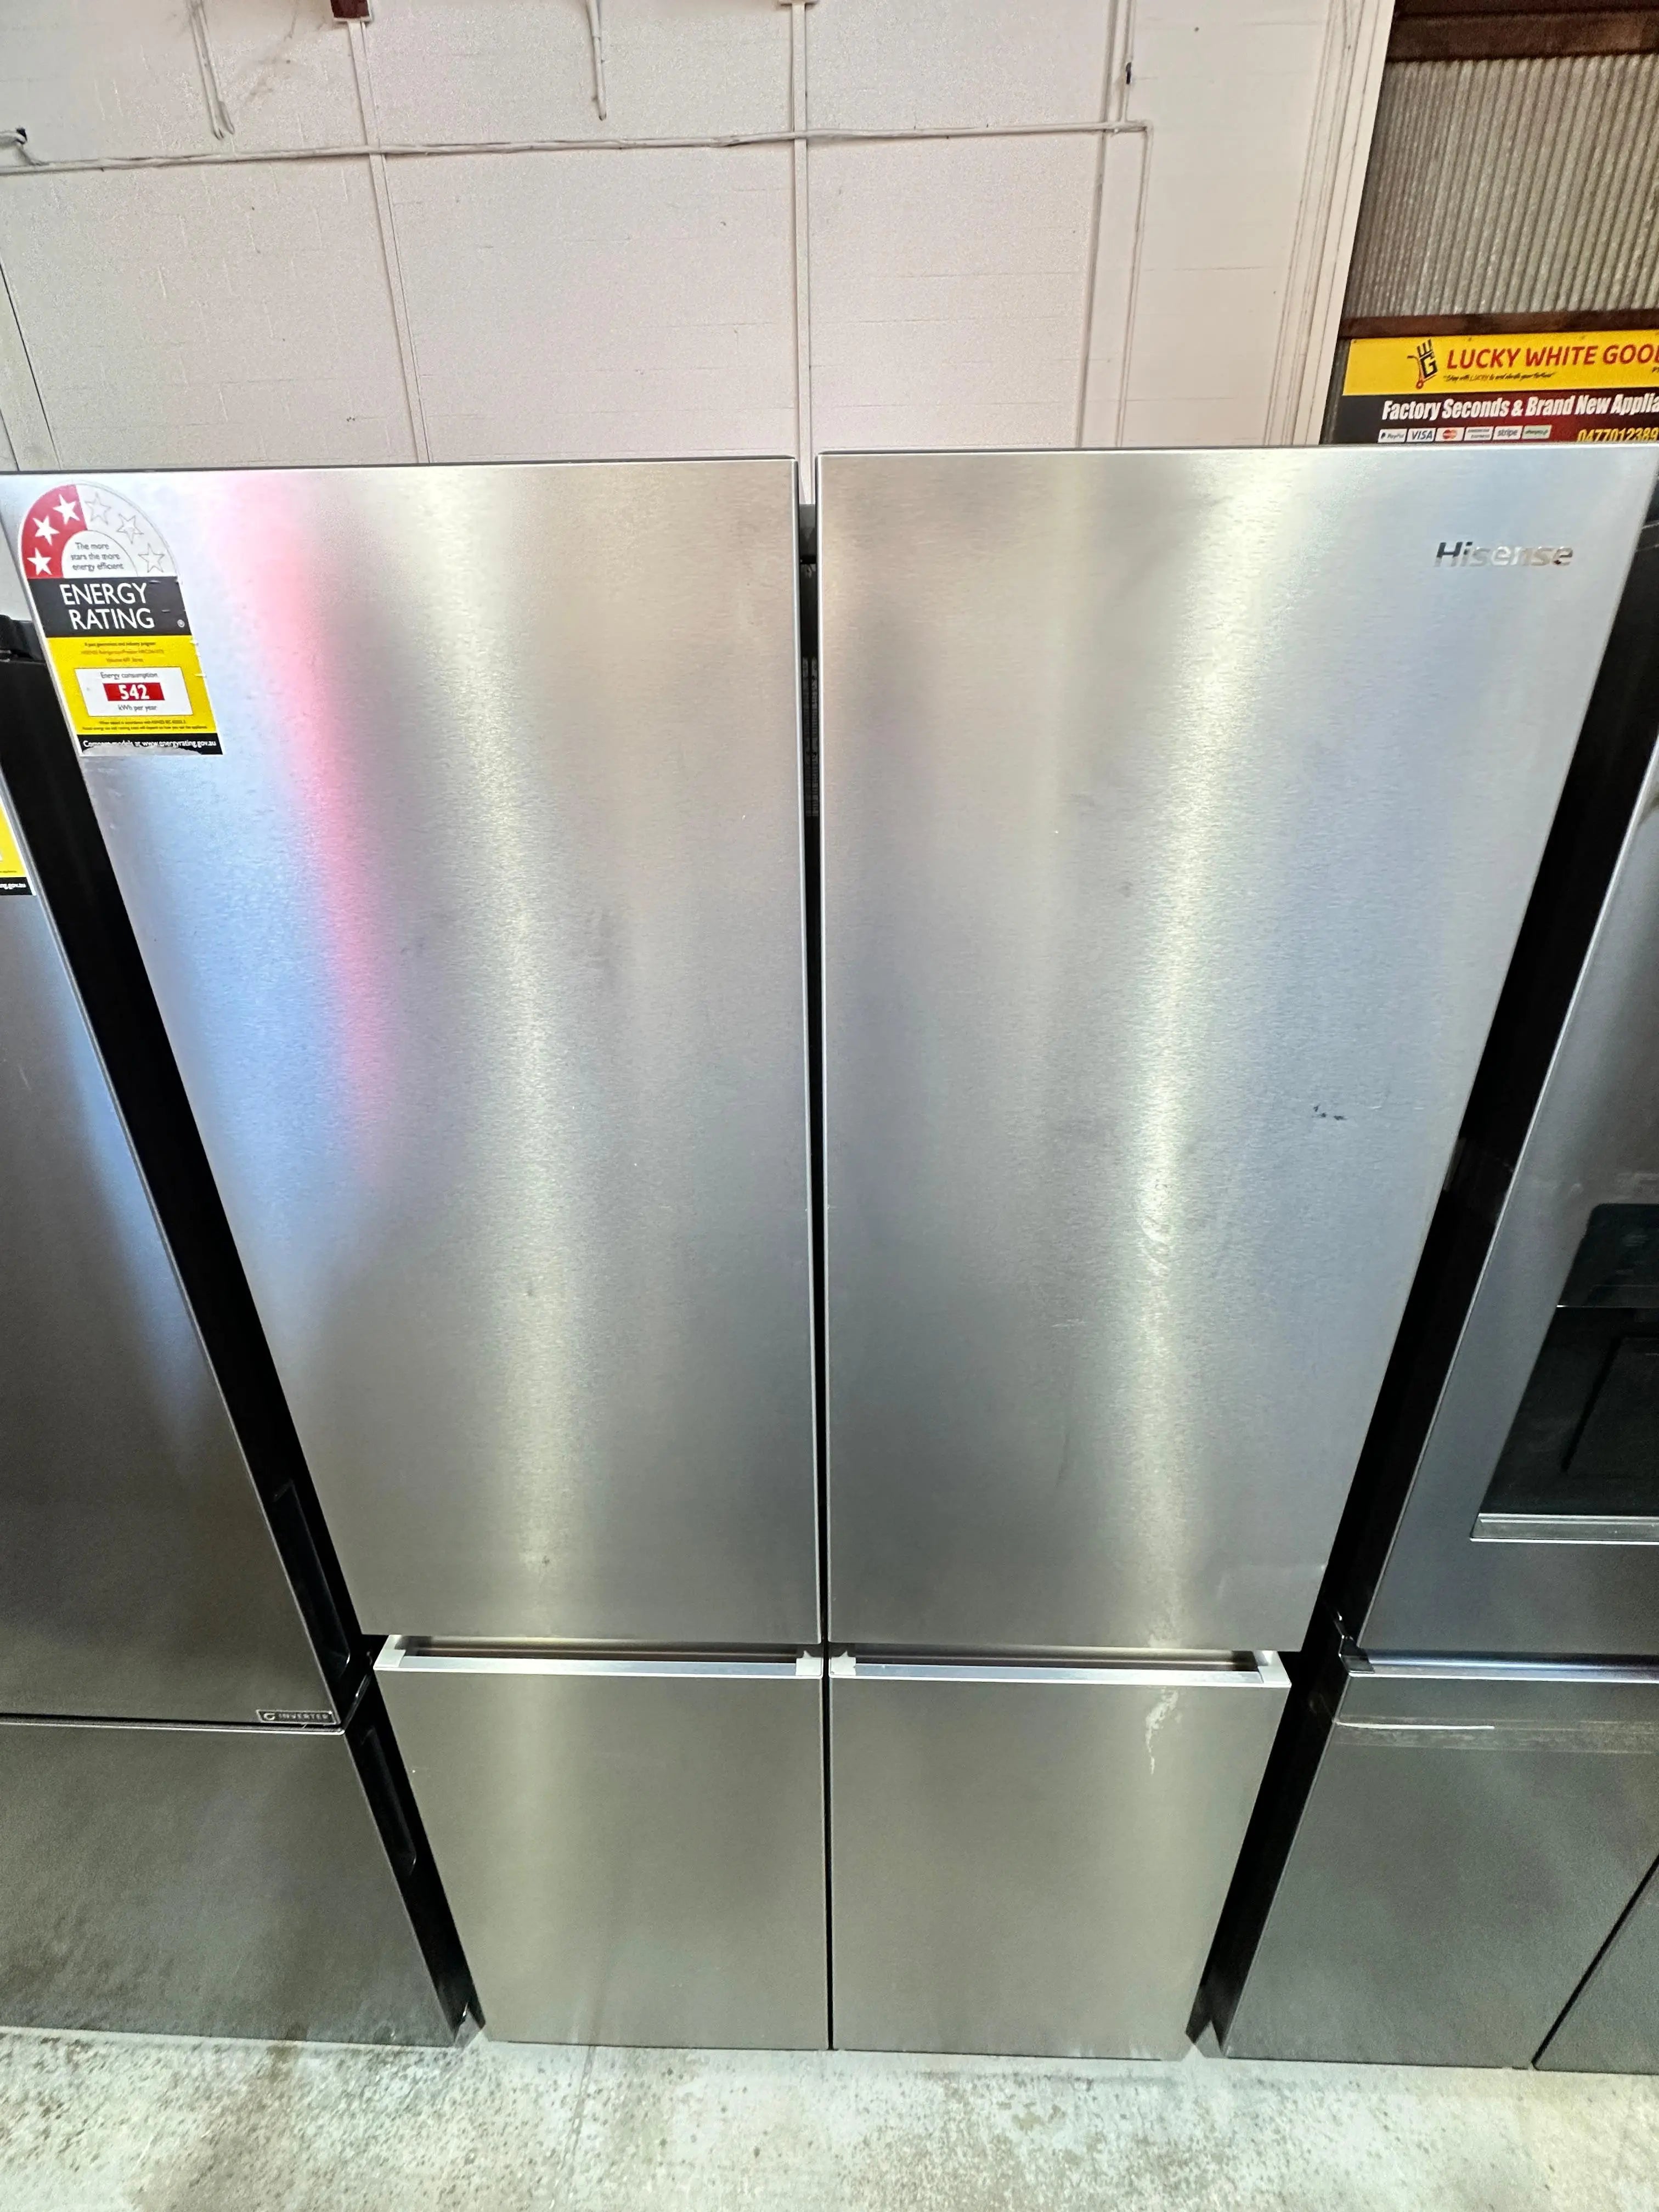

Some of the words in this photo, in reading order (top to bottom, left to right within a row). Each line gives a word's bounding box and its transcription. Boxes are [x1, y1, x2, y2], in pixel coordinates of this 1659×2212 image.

[1447, 347, 1521, 369] LUCKY
[1525, 345, 1599, 366] WHITE
[1381, 400, 1442, 421] Factory
[1442, 397, 1510, 420] Seconds
[1511, 399, 1523, 417] &
[1525, 395, 1576, 416] Brand
[1575, 394, 1612, 415] New
[1411, 430, 1433, 440] VISA
[1497, 428, 1518, 438] stripe
[75, 541, 89, 550] The
[1434, 541, 1573, 567] Hisense
[59, 582, 147, 605] ENERGY
[69, 607, 155, 630] RATING
[100, 672, 120, 680] Energy
[118, 684, 150, 700] 542
